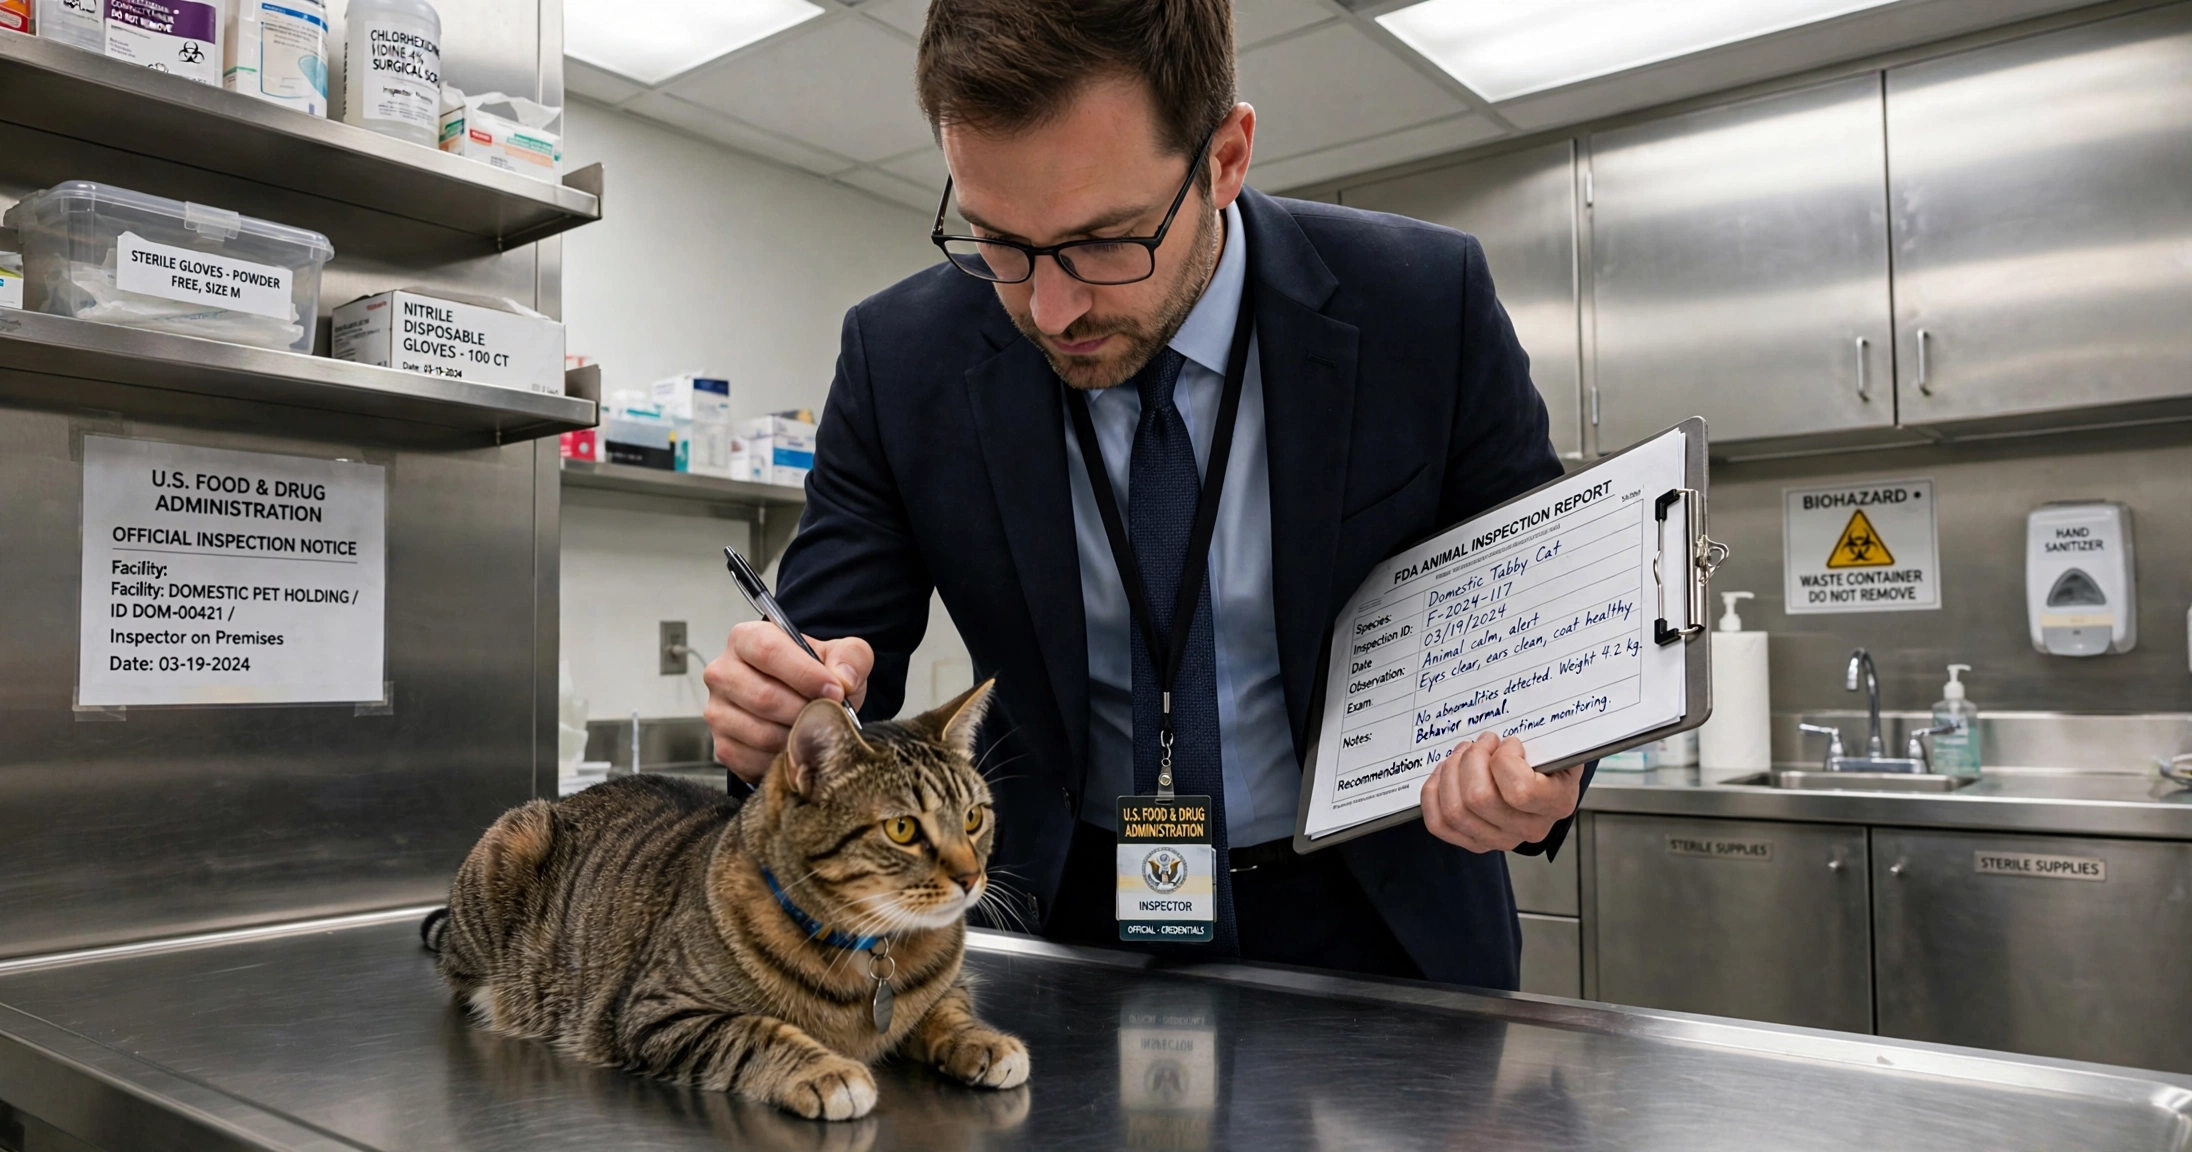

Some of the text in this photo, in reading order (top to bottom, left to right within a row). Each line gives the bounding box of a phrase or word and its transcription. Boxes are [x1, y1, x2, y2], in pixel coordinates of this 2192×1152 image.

[373, 58, 423, 79] SURGICAL
[131, 250, 176, 270] STERILE
[179, 259, 223, 279] GLOVES
[233, 270, 280, 289] POWDER
[171, 275, 241, 299] FREE, SIZE M
[404, 302, 453, 323] NITRILE
[404, 319, 486, 346] DISPOSABLE
[403, 337, 456, 359] GLOVES
[468, 349, 491, 364] 100
[494, 353, 510, 367] CT
[152, 469, 326, 501] U.S. FOOD & DRUG
[155, 494, 322, 523] ADMINISTRATION
[1803, 488, 1907, 510] BIOHAZARD
[112, 527, 357, 556] OFFICIAL INSPECTION NOTICE
[1393, 564, 1419, 585] FDA
[1420, 545, 1469, 574] ANIMAL
[1471, 507, 1551, 552] INSPECTION
[1554, 479, 1613, 517] REPORT
[2056, 527, 2090, 538] HAND
[2044, 539, 2104, 552] SANITIZER
[111, 560, 168, 579] Facility:
[1428, 577, 1484, 608] Domestic
[1490, 558, 1529, 580] Tabby
[1535, 540, 1562, 563] Cat
[1800, 569, 1923, 587] WASTE CONTAINER
[111, 581, 359, 605] Facility: DOMESTIC PET HOLDING /
[1426, 582, 1513, 627] F-2024-117
[1808, 586, 1916, 603] DO NOT REMOVE
[111, 603, 235, 621] ID DOM-00421 /
[1355, 614, 1392, 636] Species:
[1424, 603, 1507, 647] 03/19/2024
[110, 628, 284, 647] Inspector on Premises
[1353, 625, 1414, 655] Inspection ID:
[1419, 600, 1633, 693] Eyes clear, ears clean, coat healthy
[1422, 612, 1540, 669] Animal calm, alert
[109, 655, 251, 672] Date: 03-19-2024
[1351, 659, 1373, 675] Date
[1348, 667, 1406, 694] Observation:
[1415, 709, 1431, 727] No
[1503, 666, 1553, 695] detected.
[1559, 653, 1597, 676] Weight
[1601, 643, 1621, 660] 4.2
[1626, 638, 1643, 657] kg.
[1415, 698, 1510, 744] Behavior normal.
[1426, 695, 1612, 765] No continue monitoring.
[1342, 732, 1373, 750] Notes:
[1337, 756, 1423, 792] Recommendation:
[1123, 807, 1205, 821] U.S. FOOD & DRUG
[1125, 823, 1204, 837] ADMINISTRATION
[1981, 857, 2099, 876] STERILE SUPPLIES
[1139, 901, 1193, 912] INSPECTOR
